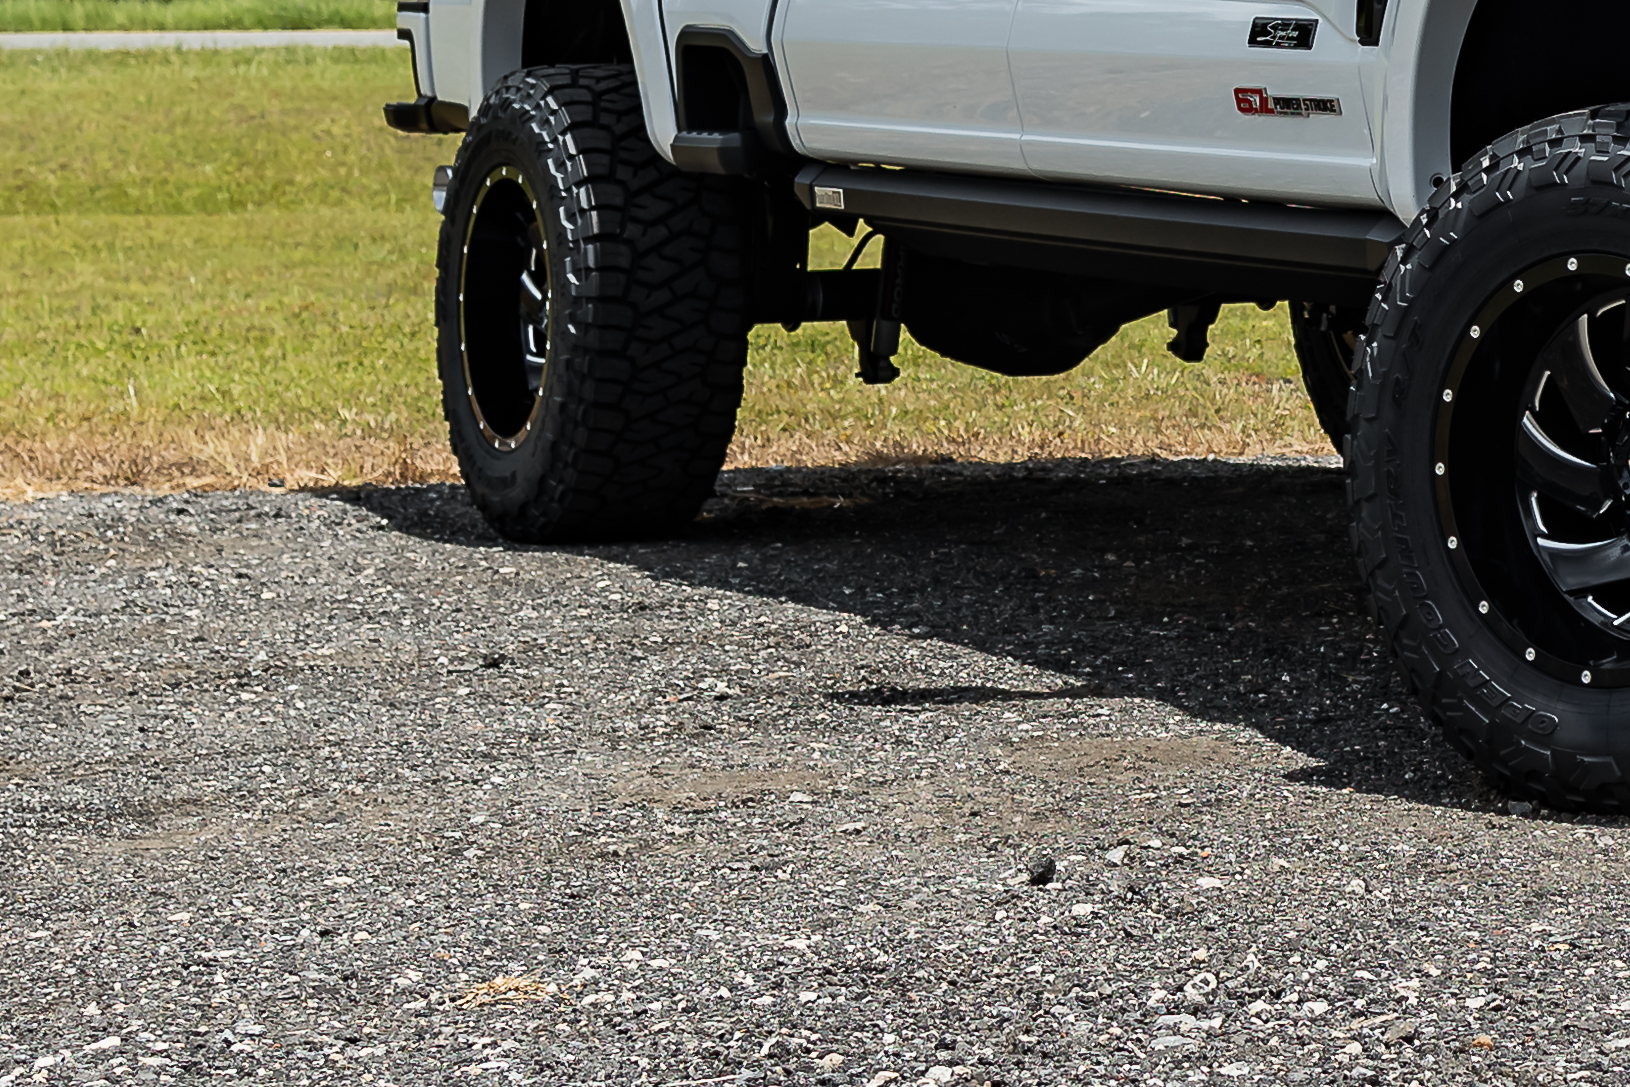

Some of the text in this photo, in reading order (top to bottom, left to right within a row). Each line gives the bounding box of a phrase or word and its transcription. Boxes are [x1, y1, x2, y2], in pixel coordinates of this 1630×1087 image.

[1274, 97, 1302, 112] POWER
[1303, 98, 1337, 113] STROKE
[1380, 428, 1460, 656] COUNTRY
[1453, 657, 1559, 736] OPEN
